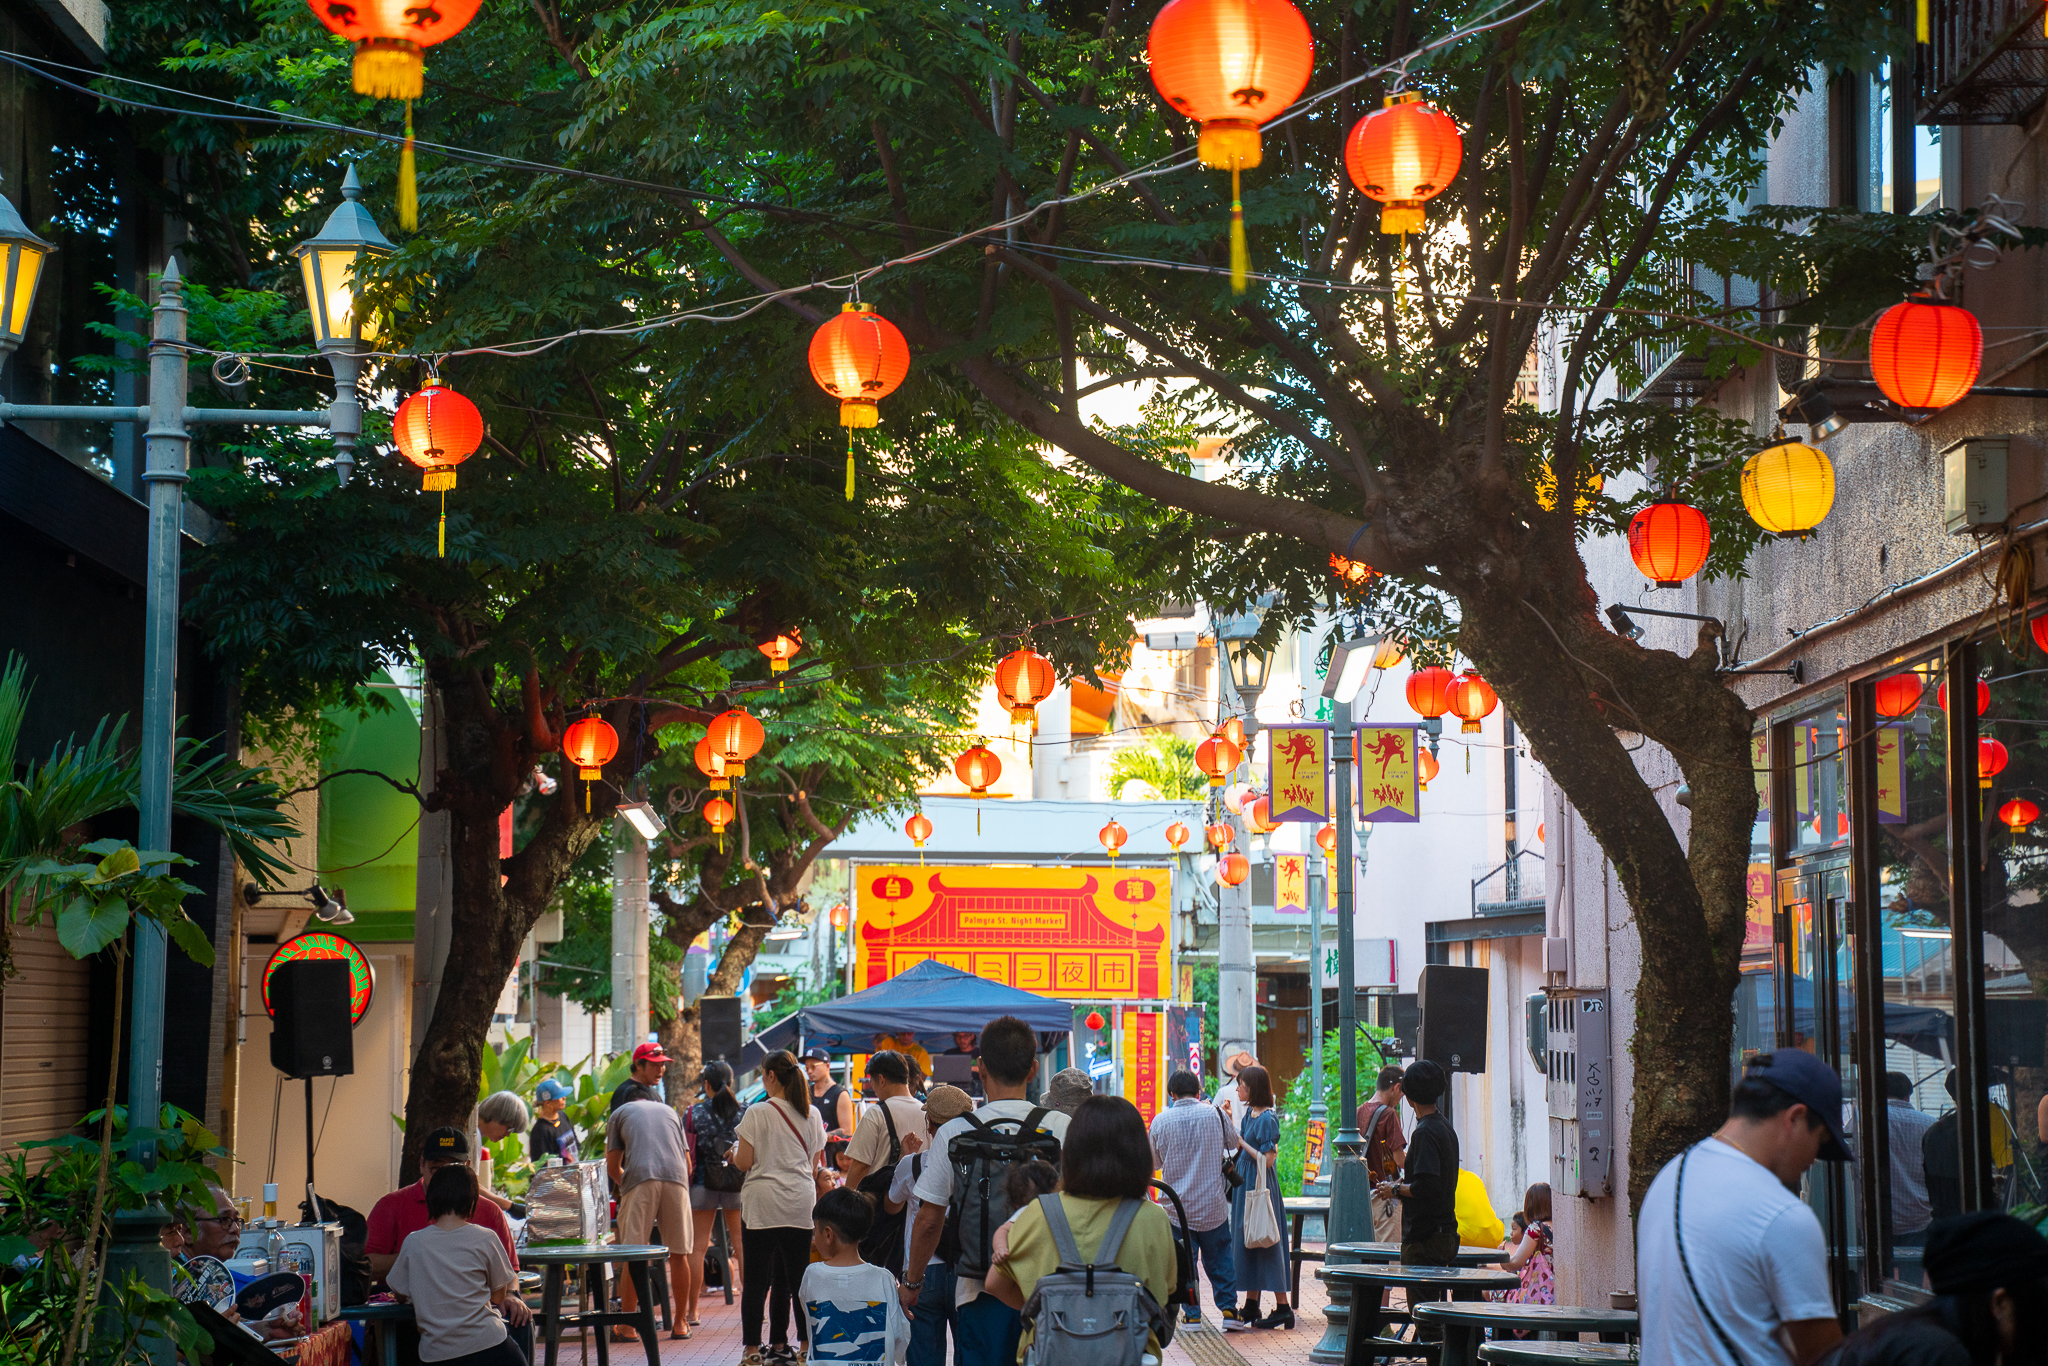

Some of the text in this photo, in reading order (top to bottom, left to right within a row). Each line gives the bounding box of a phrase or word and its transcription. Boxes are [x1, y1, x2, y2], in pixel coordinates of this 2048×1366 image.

[885, 878, 902, 897] 台
[1126, 880, 1144, 900] 湾
[964, 916, 1063, 927] Palmyra St. Night Market
[1189, 1042, 1201, 1078] KO
[1138, 1029, 1152, 1132] Palmyra St. Nigh
